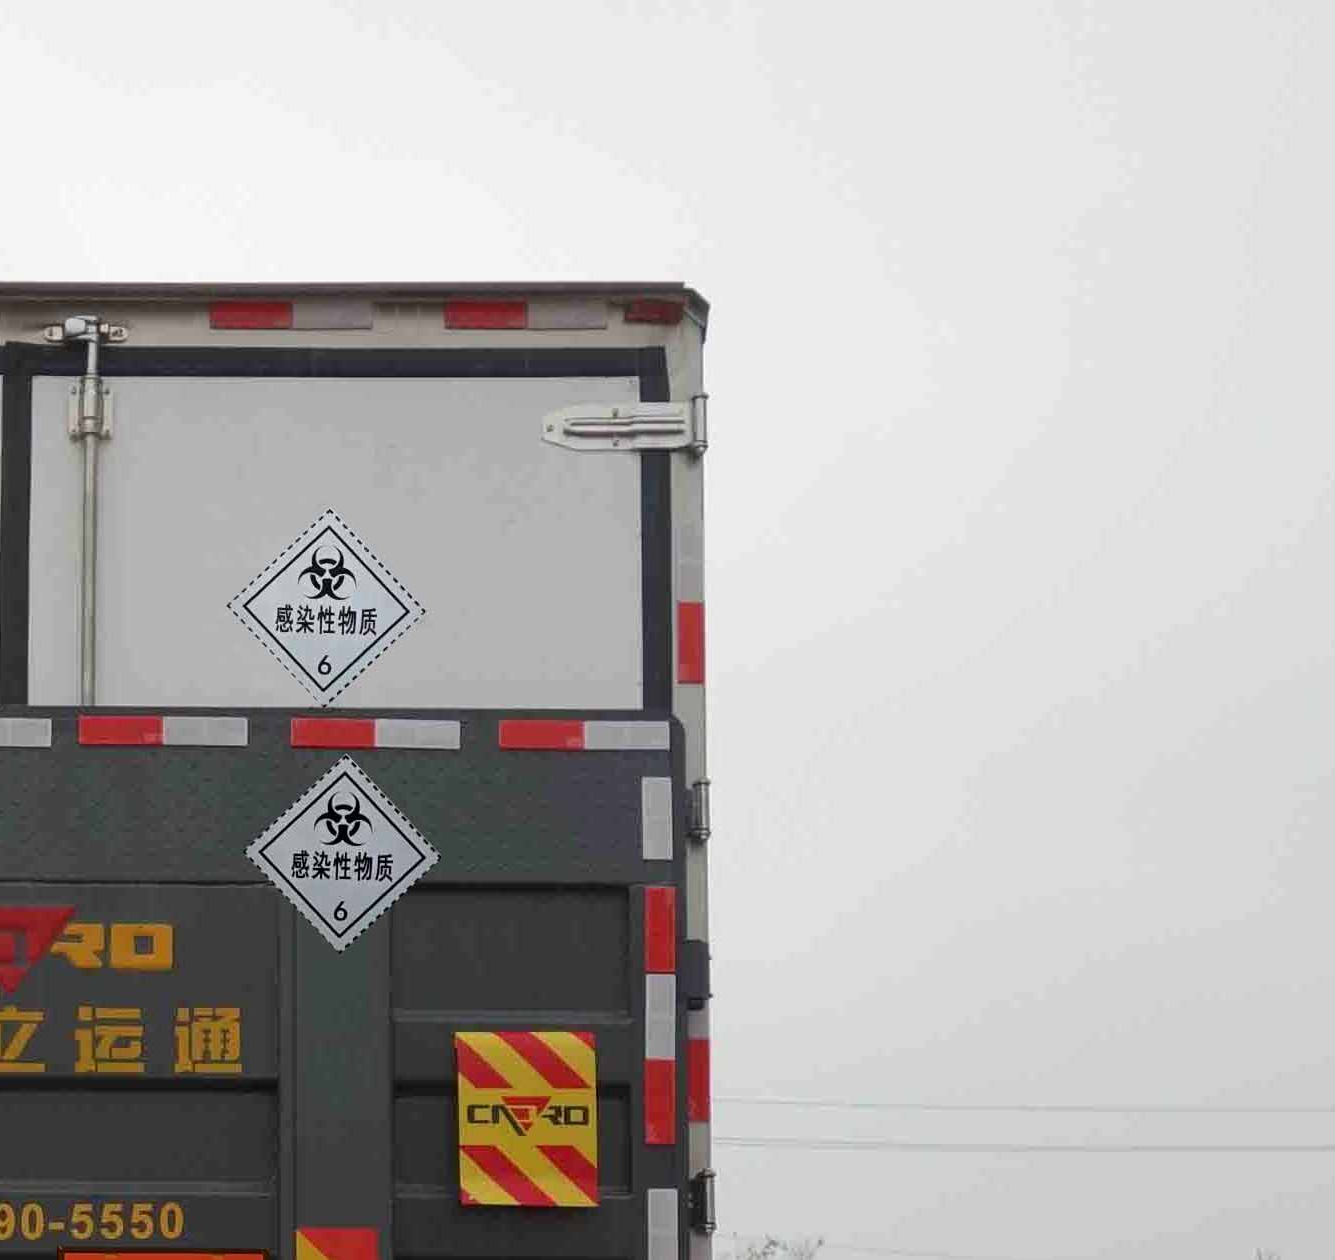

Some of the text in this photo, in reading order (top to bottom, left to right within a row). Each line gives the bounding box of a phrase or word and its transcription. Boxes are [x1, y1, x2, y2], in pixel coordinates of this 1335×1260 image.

[275, 605, 378, 636] 感染性物质
[317, 655, 332, 676] 6
[290, 851, 393, 882] 感染性物质
[333, 901, 348, 922] 6
